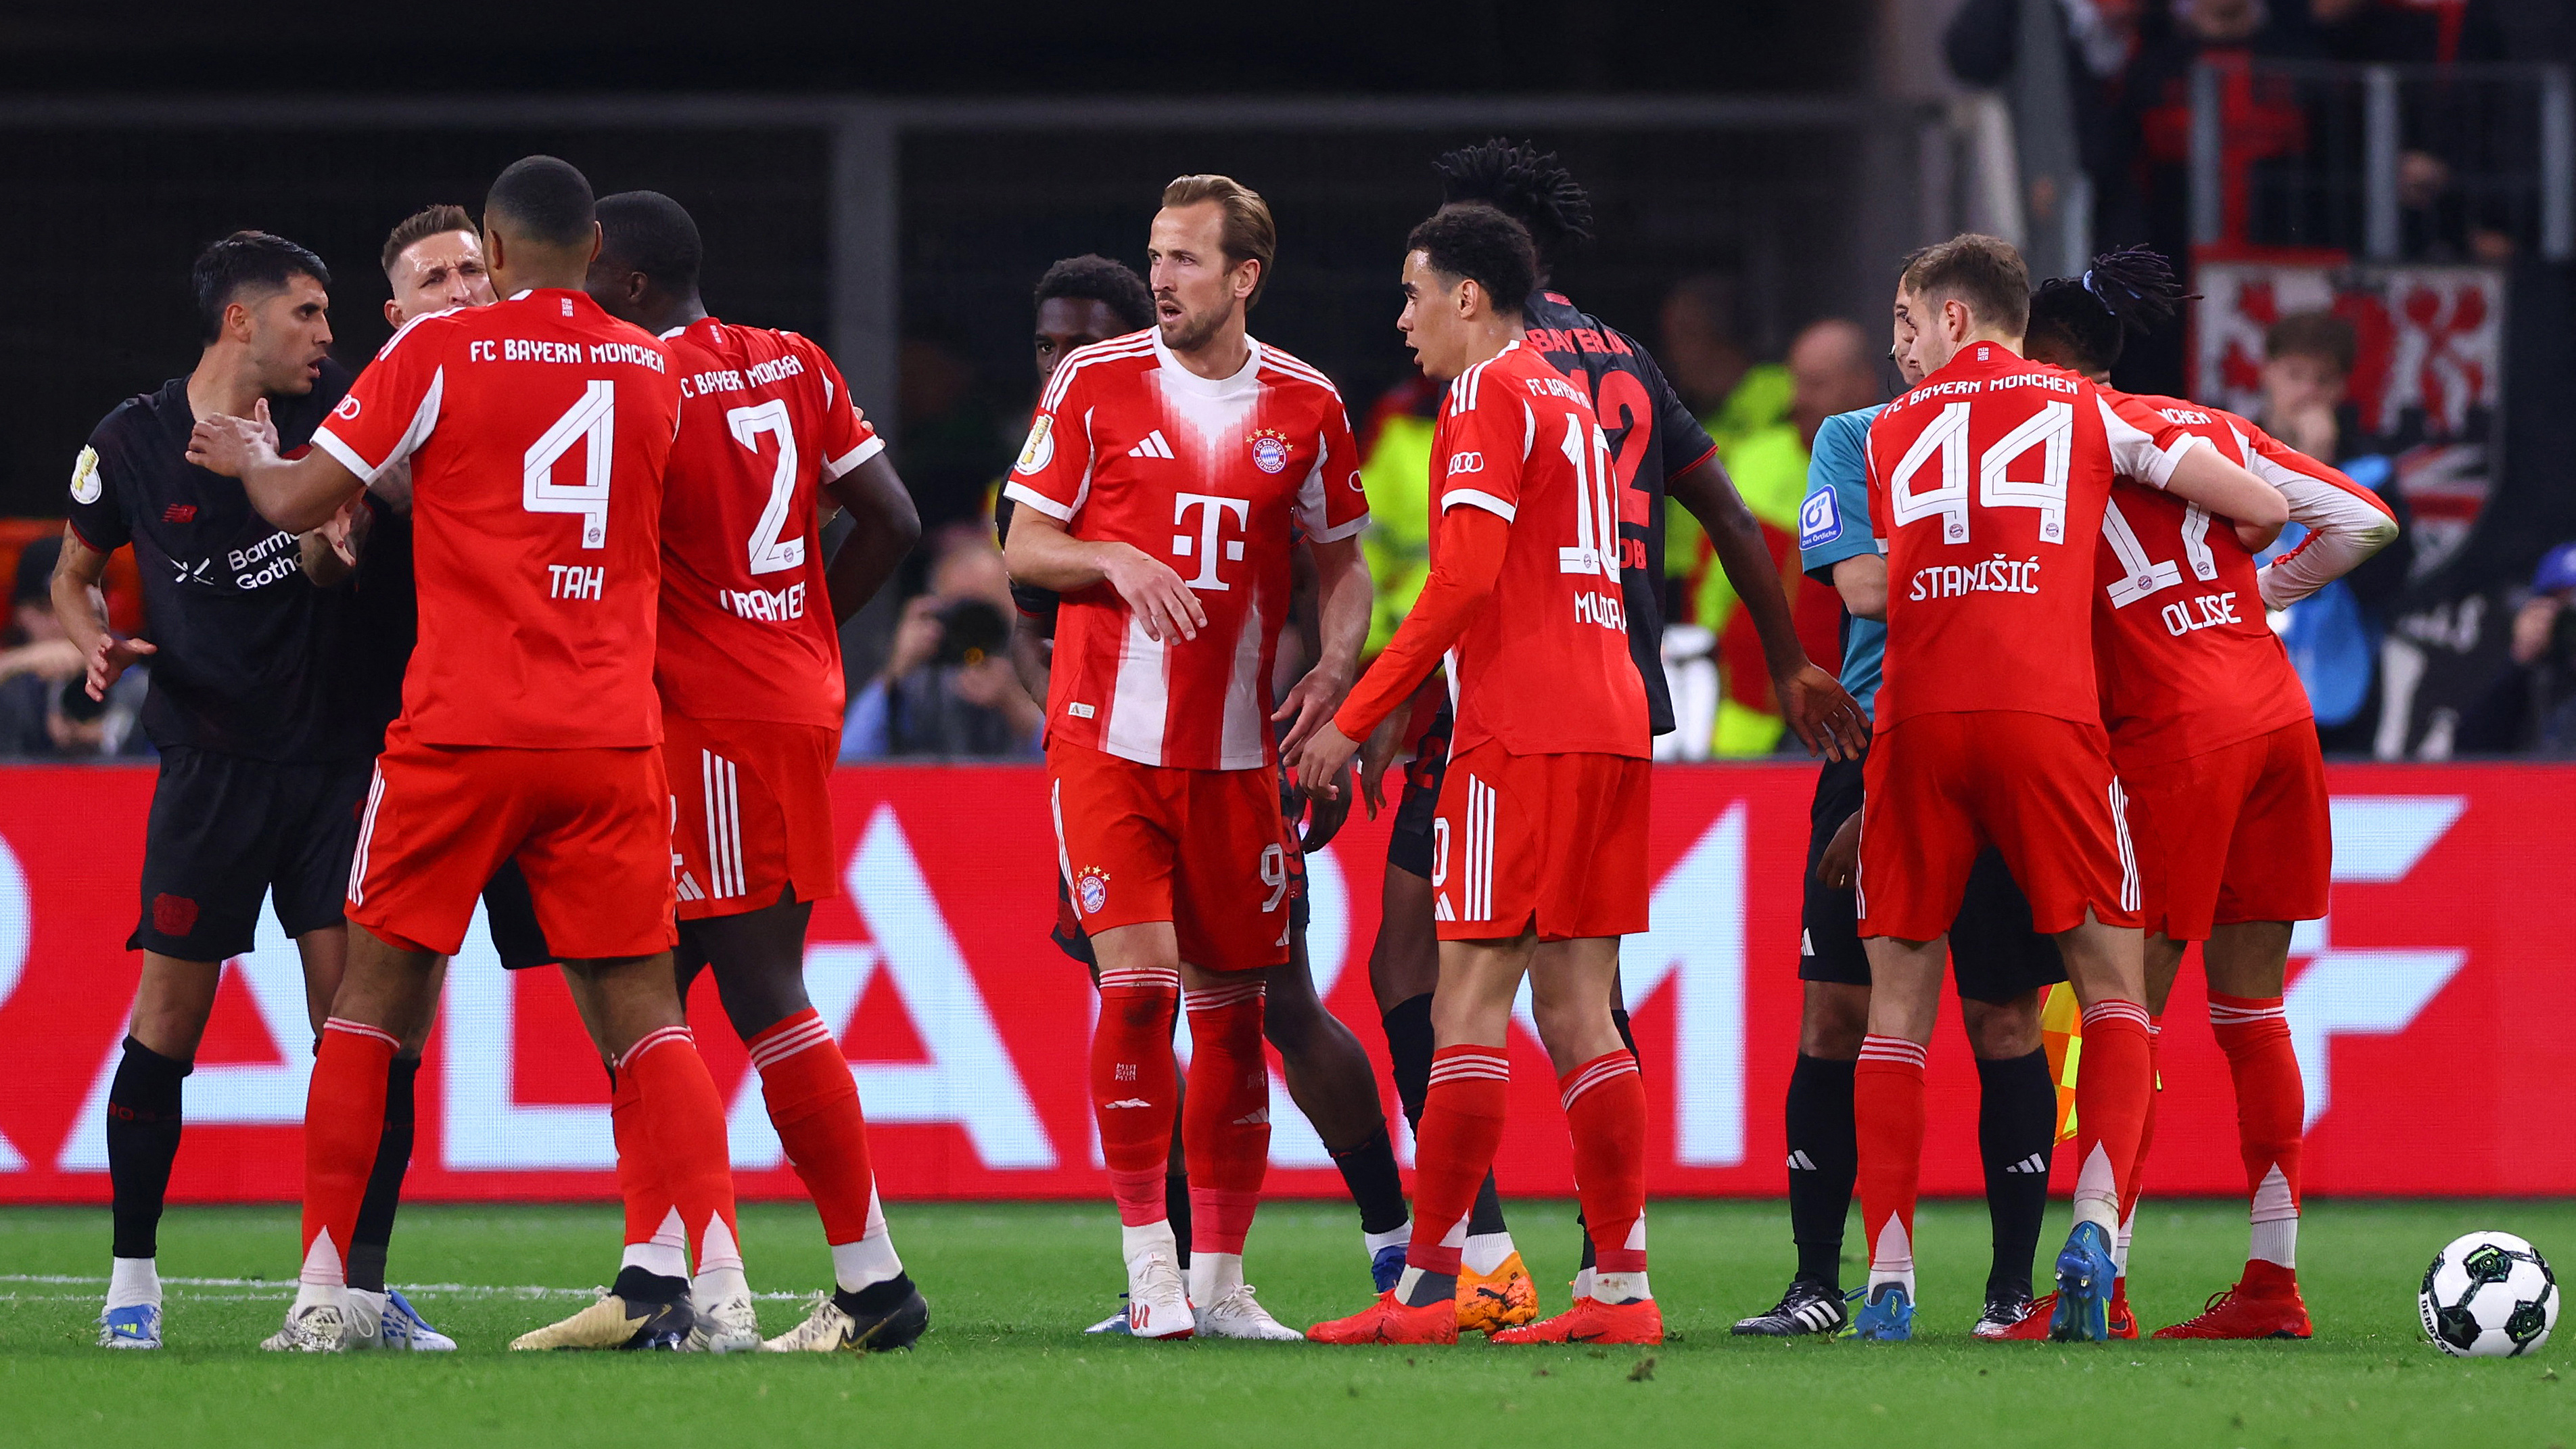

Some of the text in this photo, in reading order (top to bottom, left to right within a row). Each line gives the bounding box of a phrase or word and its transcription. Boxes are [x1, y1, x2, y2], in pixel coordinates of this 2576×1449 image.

[470, 339, 665, 374] FC BAYERN MÜNCHEN
[680, 377, 695, 398] C
[1526, 378, 1547, 396] FC
[1883, 373, 2078, 419] FC BAYERN MÜNCHEN
[523, 380, 614, 549] 4
[726, 398, 805, 575] 2
[1891, 399, 2073, 545] 44
[1559, 413, 1622, 584] 10
[548, 564, 604, 601] TAH
[1909, 553, 2040, 601] STANIŠIĆ
[2161, 592, 2241, 637] OLISE
[1260, 842, 1286, 913] 9
